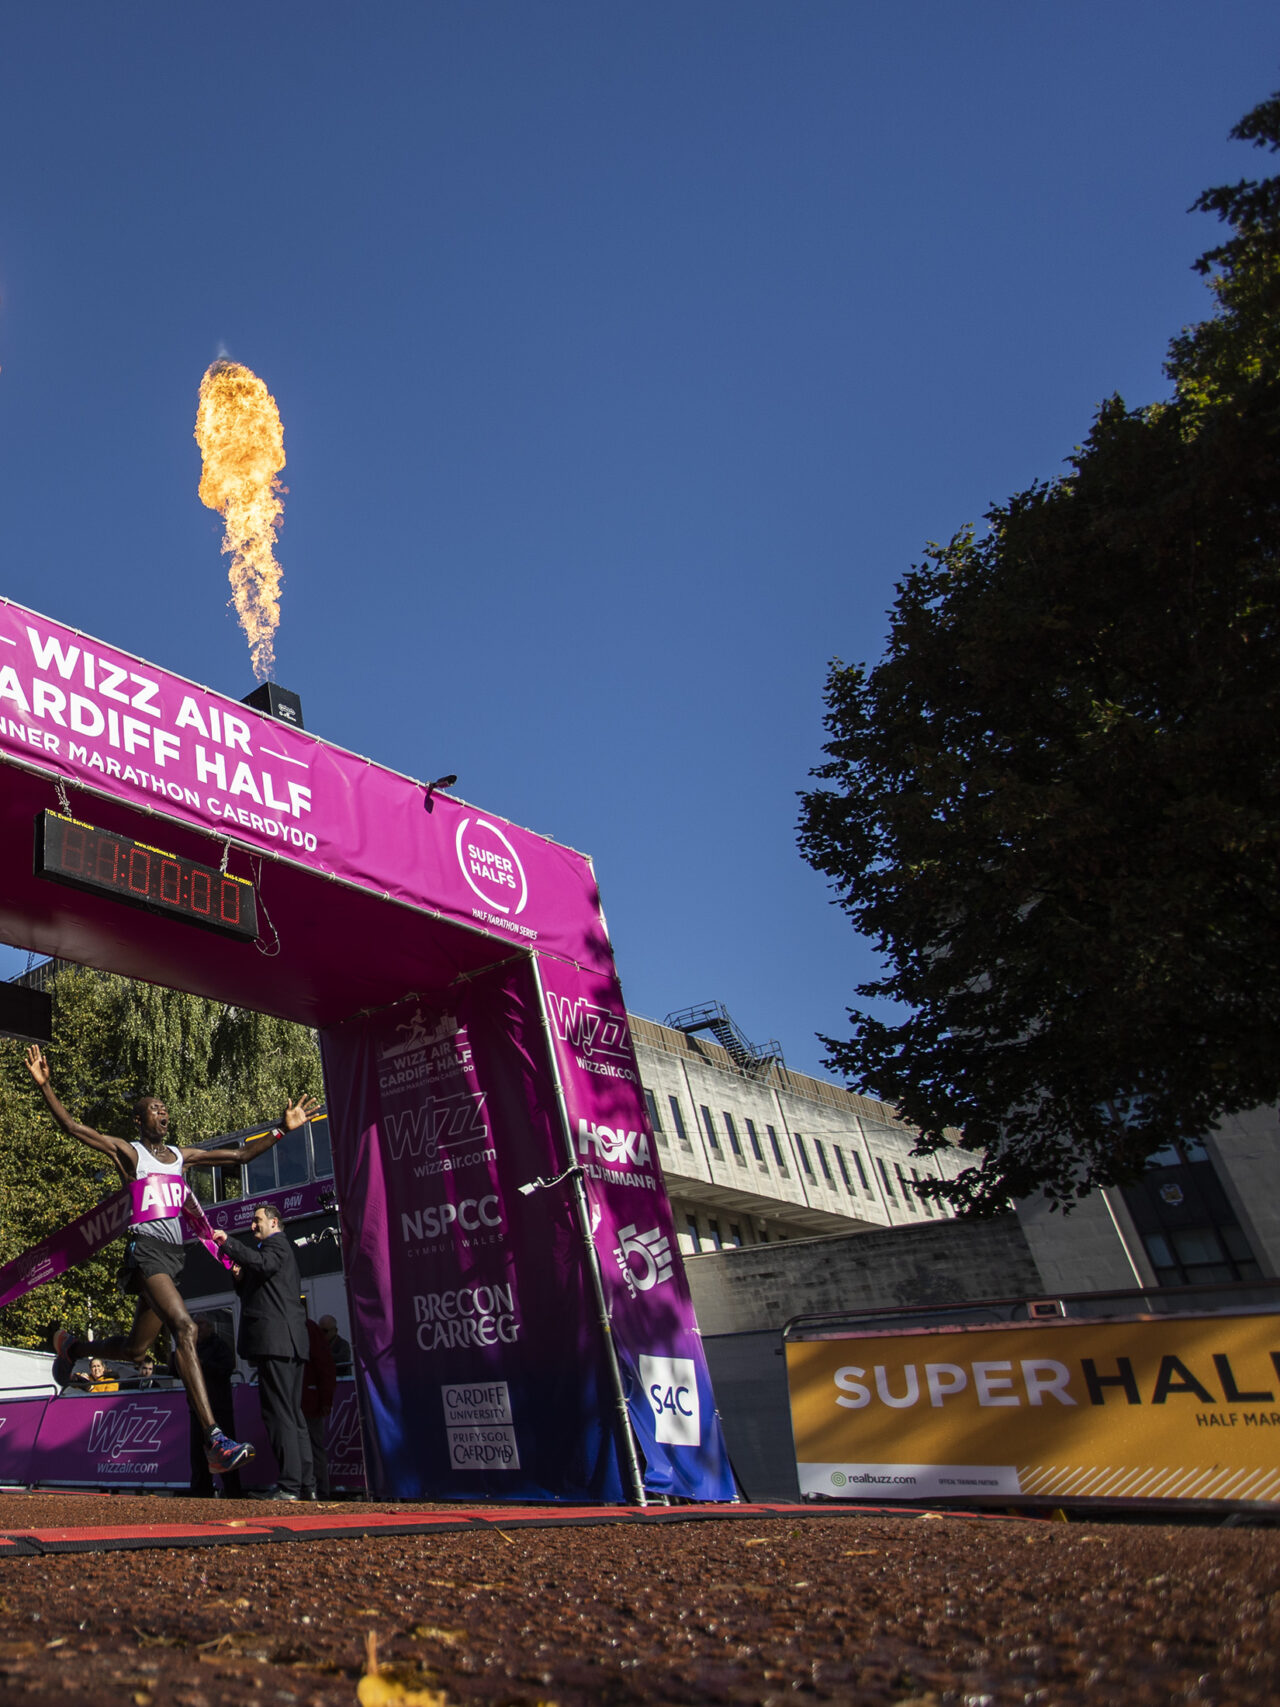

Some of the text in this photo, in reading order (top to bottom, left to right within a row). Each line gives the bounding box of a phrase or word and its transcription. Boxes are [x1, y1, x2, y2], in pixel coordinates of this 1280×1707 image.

[26, 625, 254, 757] WIZZ AIR
[195, 743, 312, 819] HALF
[69, 745, 200, 809] MARATHON
[207, 796, 318, 853] CAERDYDD
[467, 844, 514, 873] SUPER
[470, 860, 517, 889] HALFS
[472, 908, 538, 940] HALF MARATHON SERIES
[379, 1049, 472, 1088] CARDIFF HALF
[394, 1042, 451, 1070] WIZZ AIR
[578, 1118, 653, 1170] HOKA
[414, 1147, 497, 1178] wizzair.com
[584, 1163, 602, 1179] FLY
[602, 1168, 645, 1188] HUMAN
[141, 1183, 182, 1212] AIR
[284, 1194, 303, 1209] RAW
[400, 1194, 502, 1243] NSPCC
[407, 1233, 504, 1258] CYMRU WALES
[413, 1282, 515, 1323] BRECON
[415, 1314, 521, 1351] CARREG
[445, 1385, 504, 1408] CARDIFF
[650, 1384, 693, 1418] S4C
[449, 1407, 506, 1421] UNIVERSITY
[1195, 1413, 1238, 1428] HALF
[452, 1431, 510, 1443] PRIFYSGOL
[97, 1459, 159, 1475] wizzair.com
[453, 1443, 514, 1466] CAERDYDD
[848, 1473, 916, 1485] realbuzz.com
